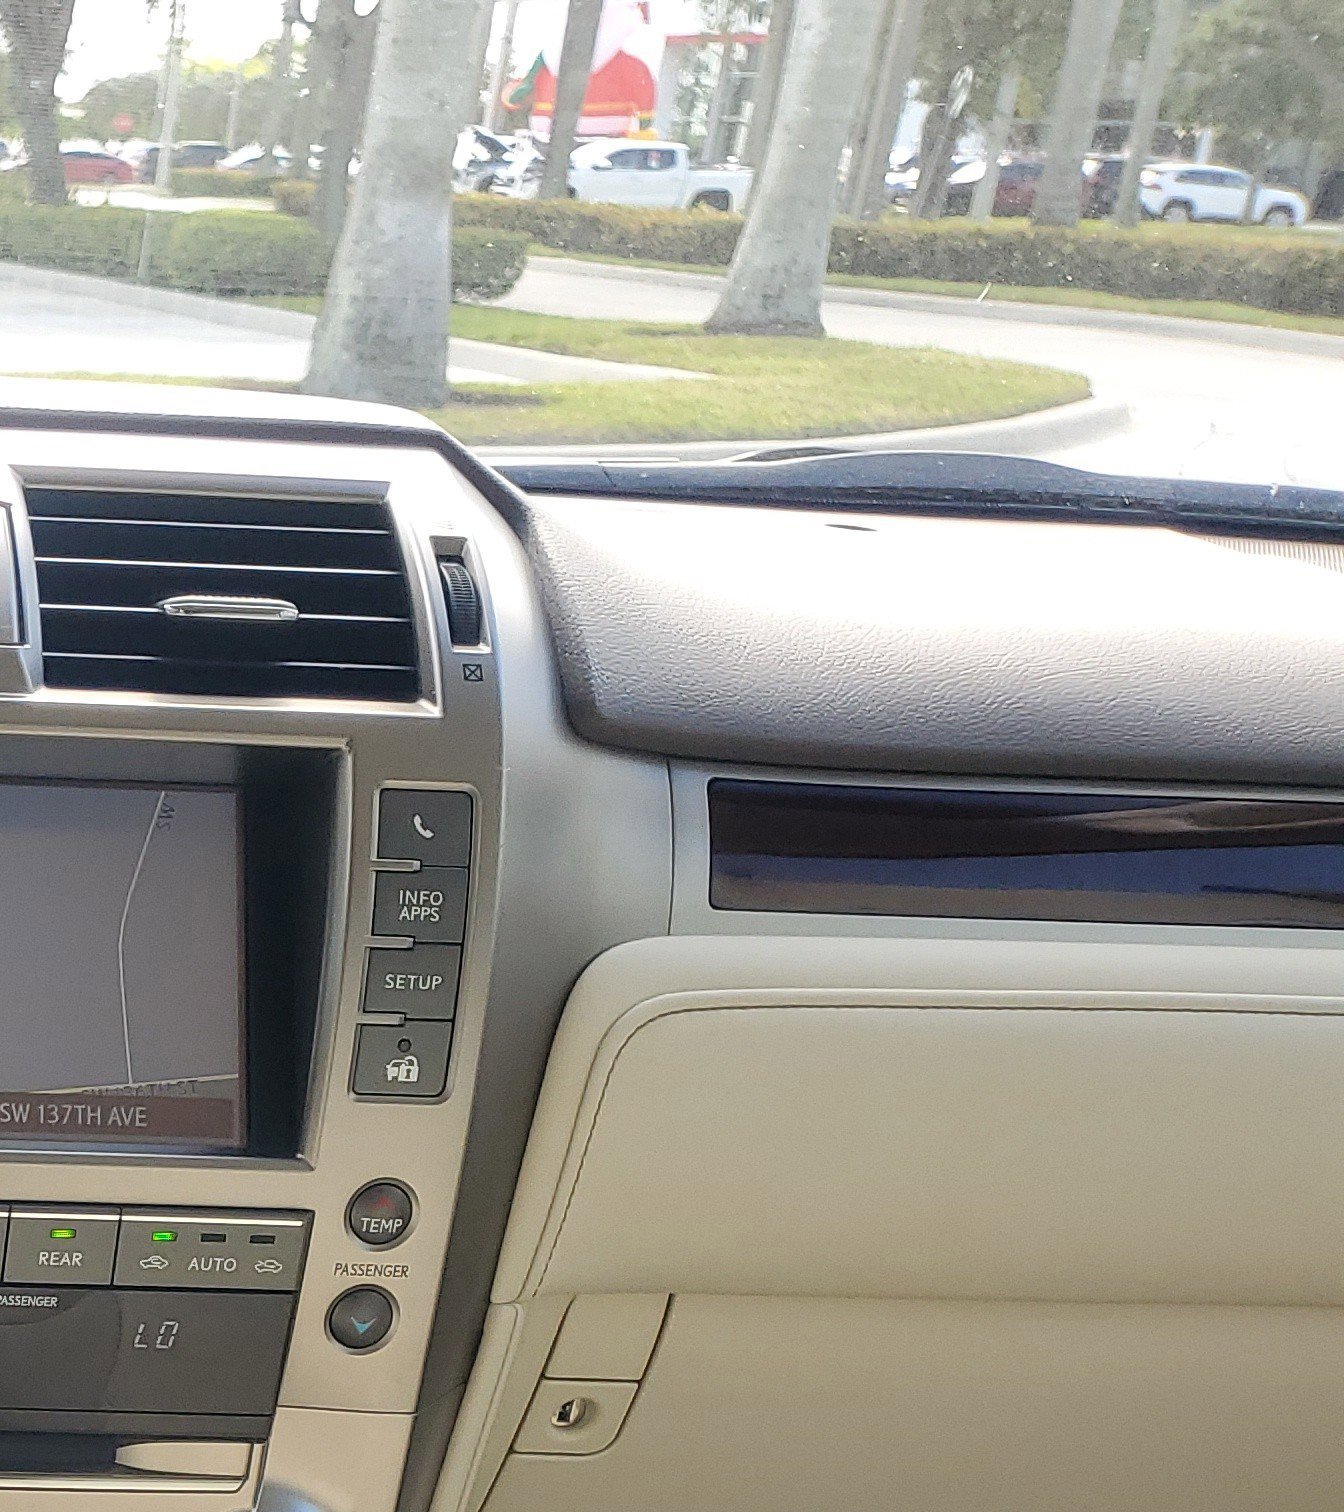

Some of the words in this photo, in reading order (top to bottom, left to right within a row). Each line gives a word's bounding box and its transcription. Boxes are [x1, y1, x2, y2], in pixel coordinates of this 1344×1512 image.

[399, 889, 444, 906] INFO
[398, 906, 441, 923] APPS
[384, 973, 443, 991] SETUP
[0, 1102, 31, 1124] SW
[38, 1104, 102, 1127] 137TH
[108, 1106, 148, 1128] AVE
[360, 1217, 404, 1234] TEMP
[37, 1251, 83, 1267] REAR
[187, 1257, 238, 1273] AUTO
[333, 1262, 410, 1279] PASSENGER
